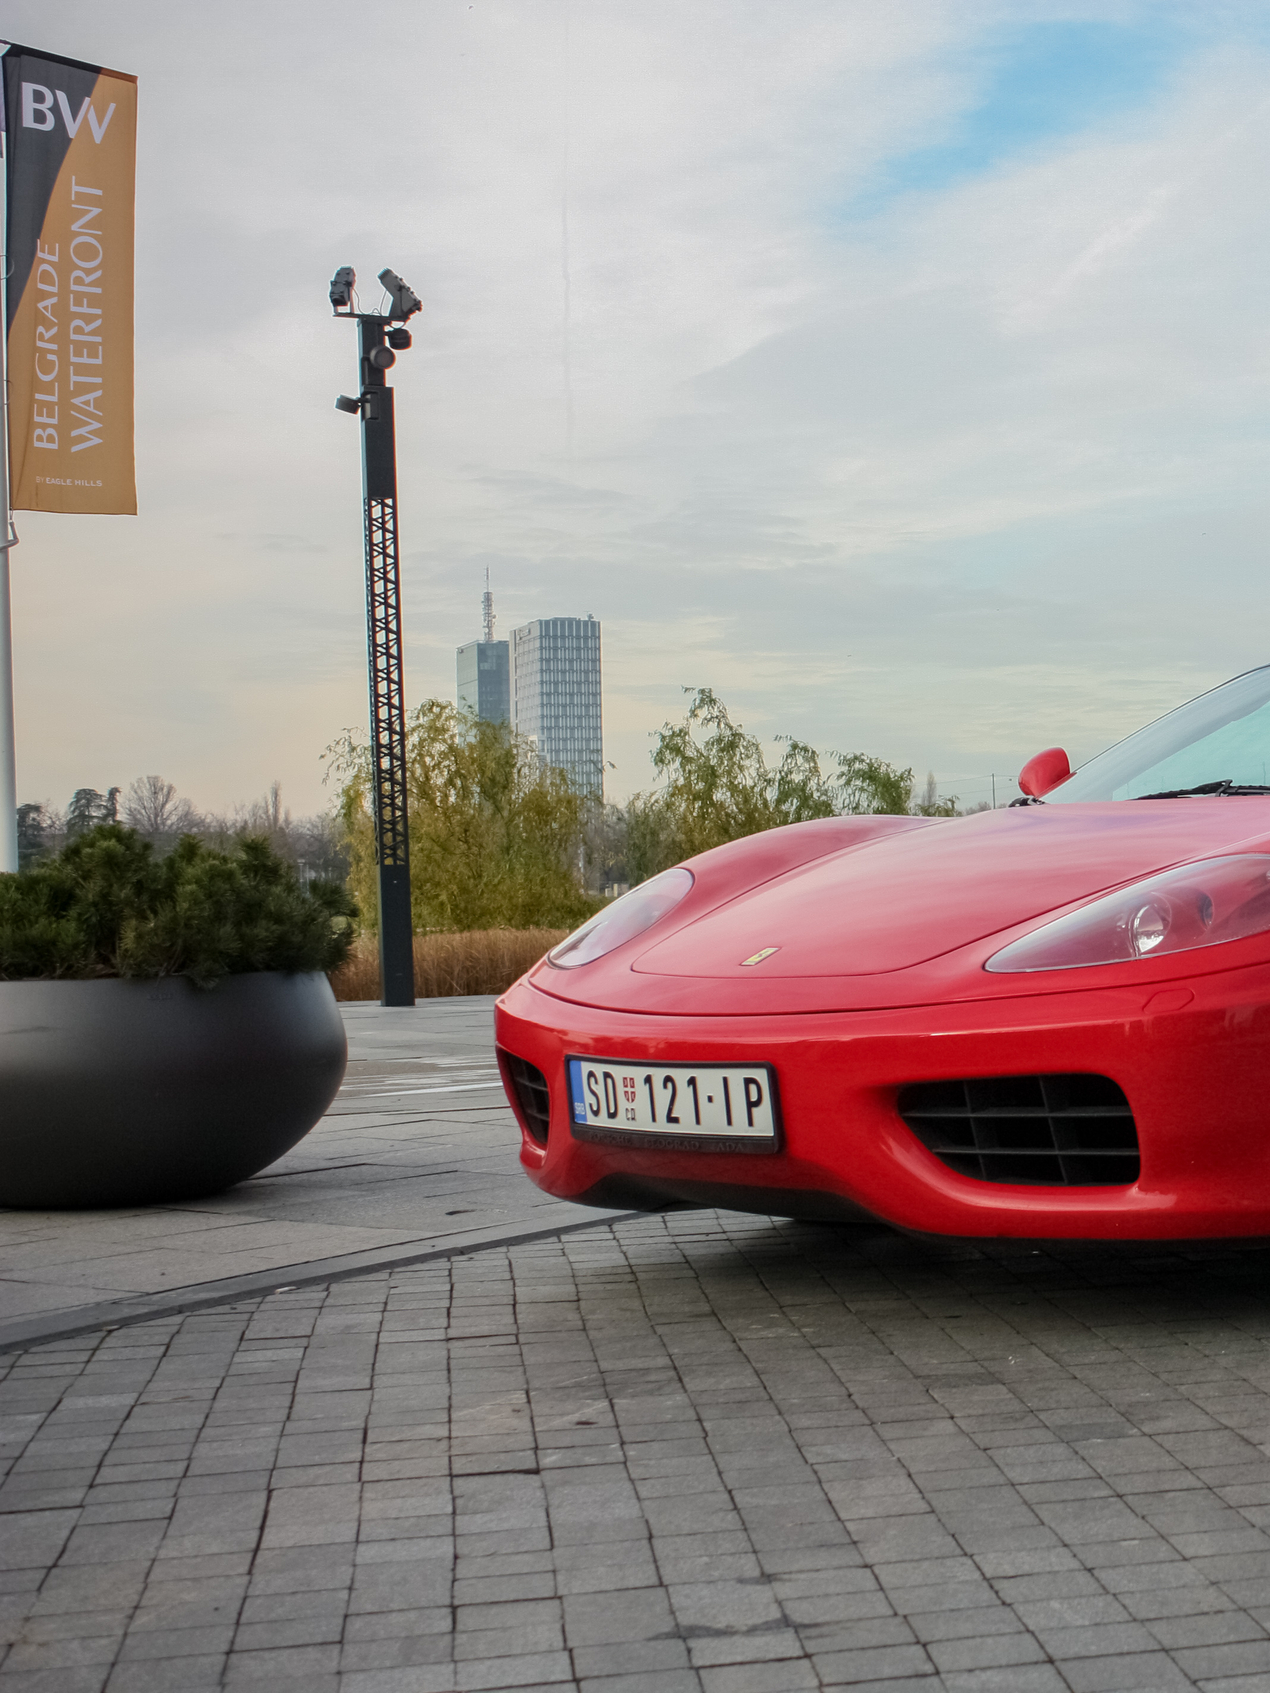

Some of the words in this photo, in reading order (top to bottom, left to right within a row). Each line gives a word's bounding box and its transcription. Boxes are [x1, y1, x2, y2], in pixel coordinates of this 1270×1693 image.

[21, 81, 116, 144] BW
[70, 175, 103, 453] WATERFRONT
[34, 239, 59, 449] BELGRADE
[35, 476, 45, 484] BY
[45, 477, 73, 486] EAGLE
[75, 479, 103, 487] HILLS
[574, 1102, 586, 1115] SRB
[586, 1069, 619, 1120] SD
